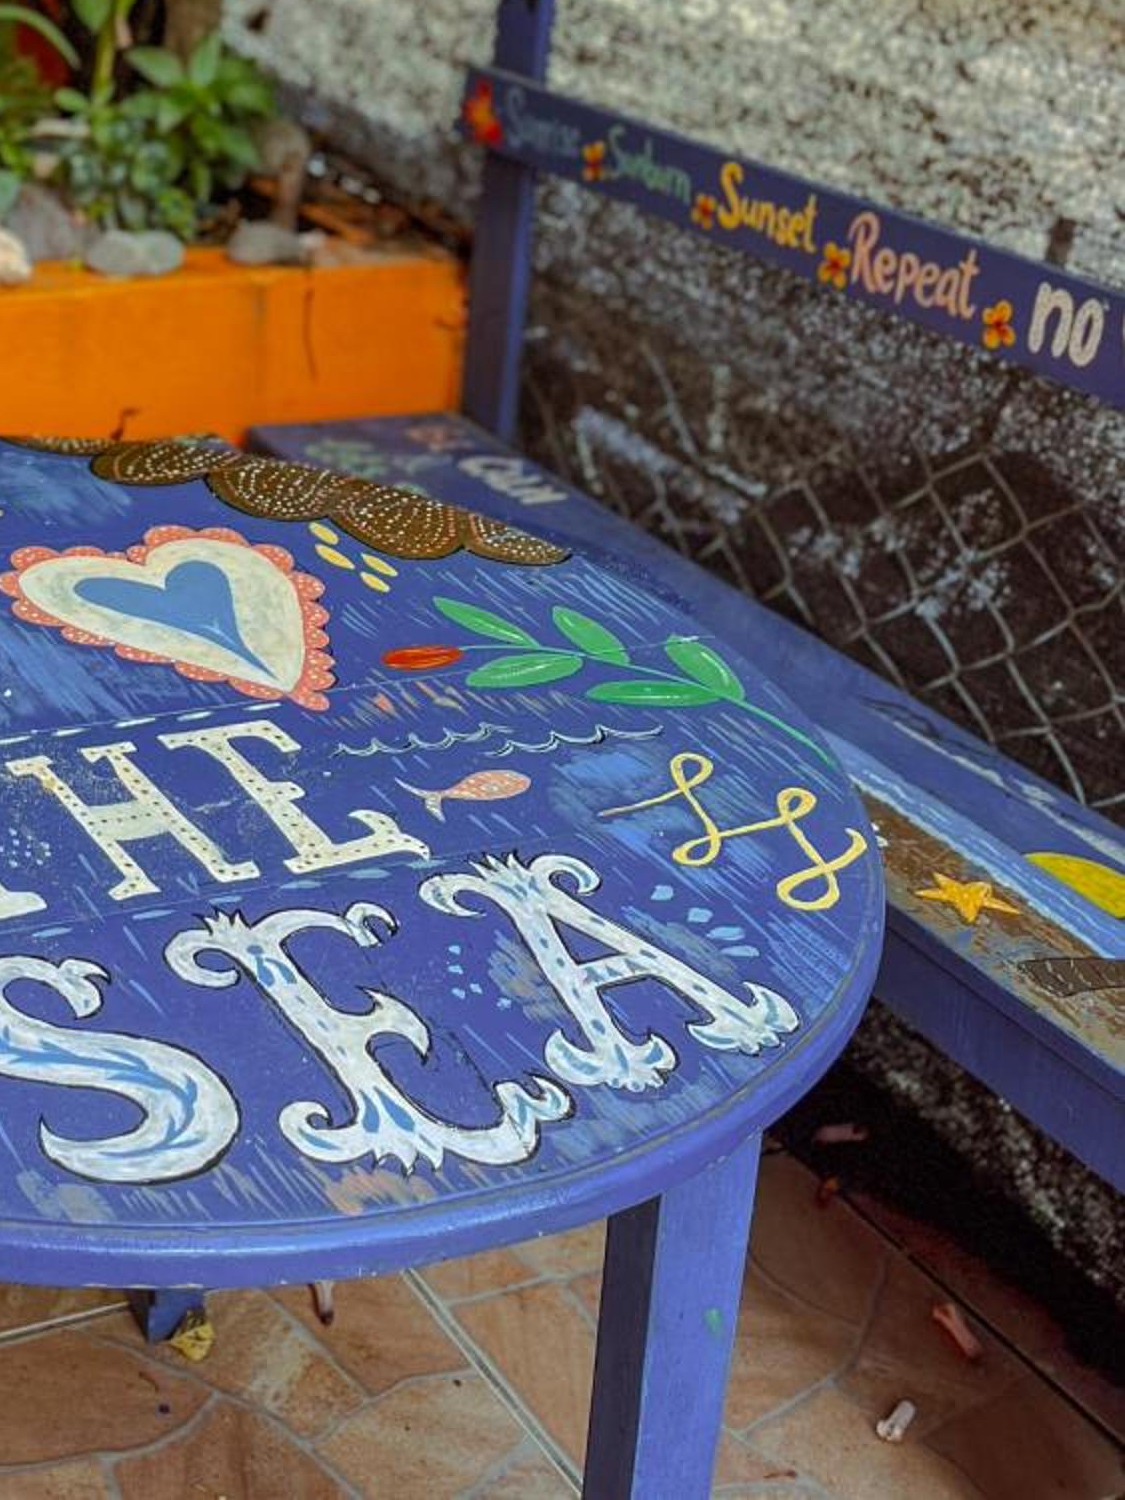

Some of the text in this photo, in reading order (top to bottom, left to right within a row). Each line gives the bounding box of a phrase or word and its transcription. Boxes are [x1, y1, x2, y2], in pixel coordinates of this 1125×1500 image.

[716, 161, 817, 254] Sunset
[847, 211, 980, 320] Repeat
[1027, 280, 1105, 368] no
